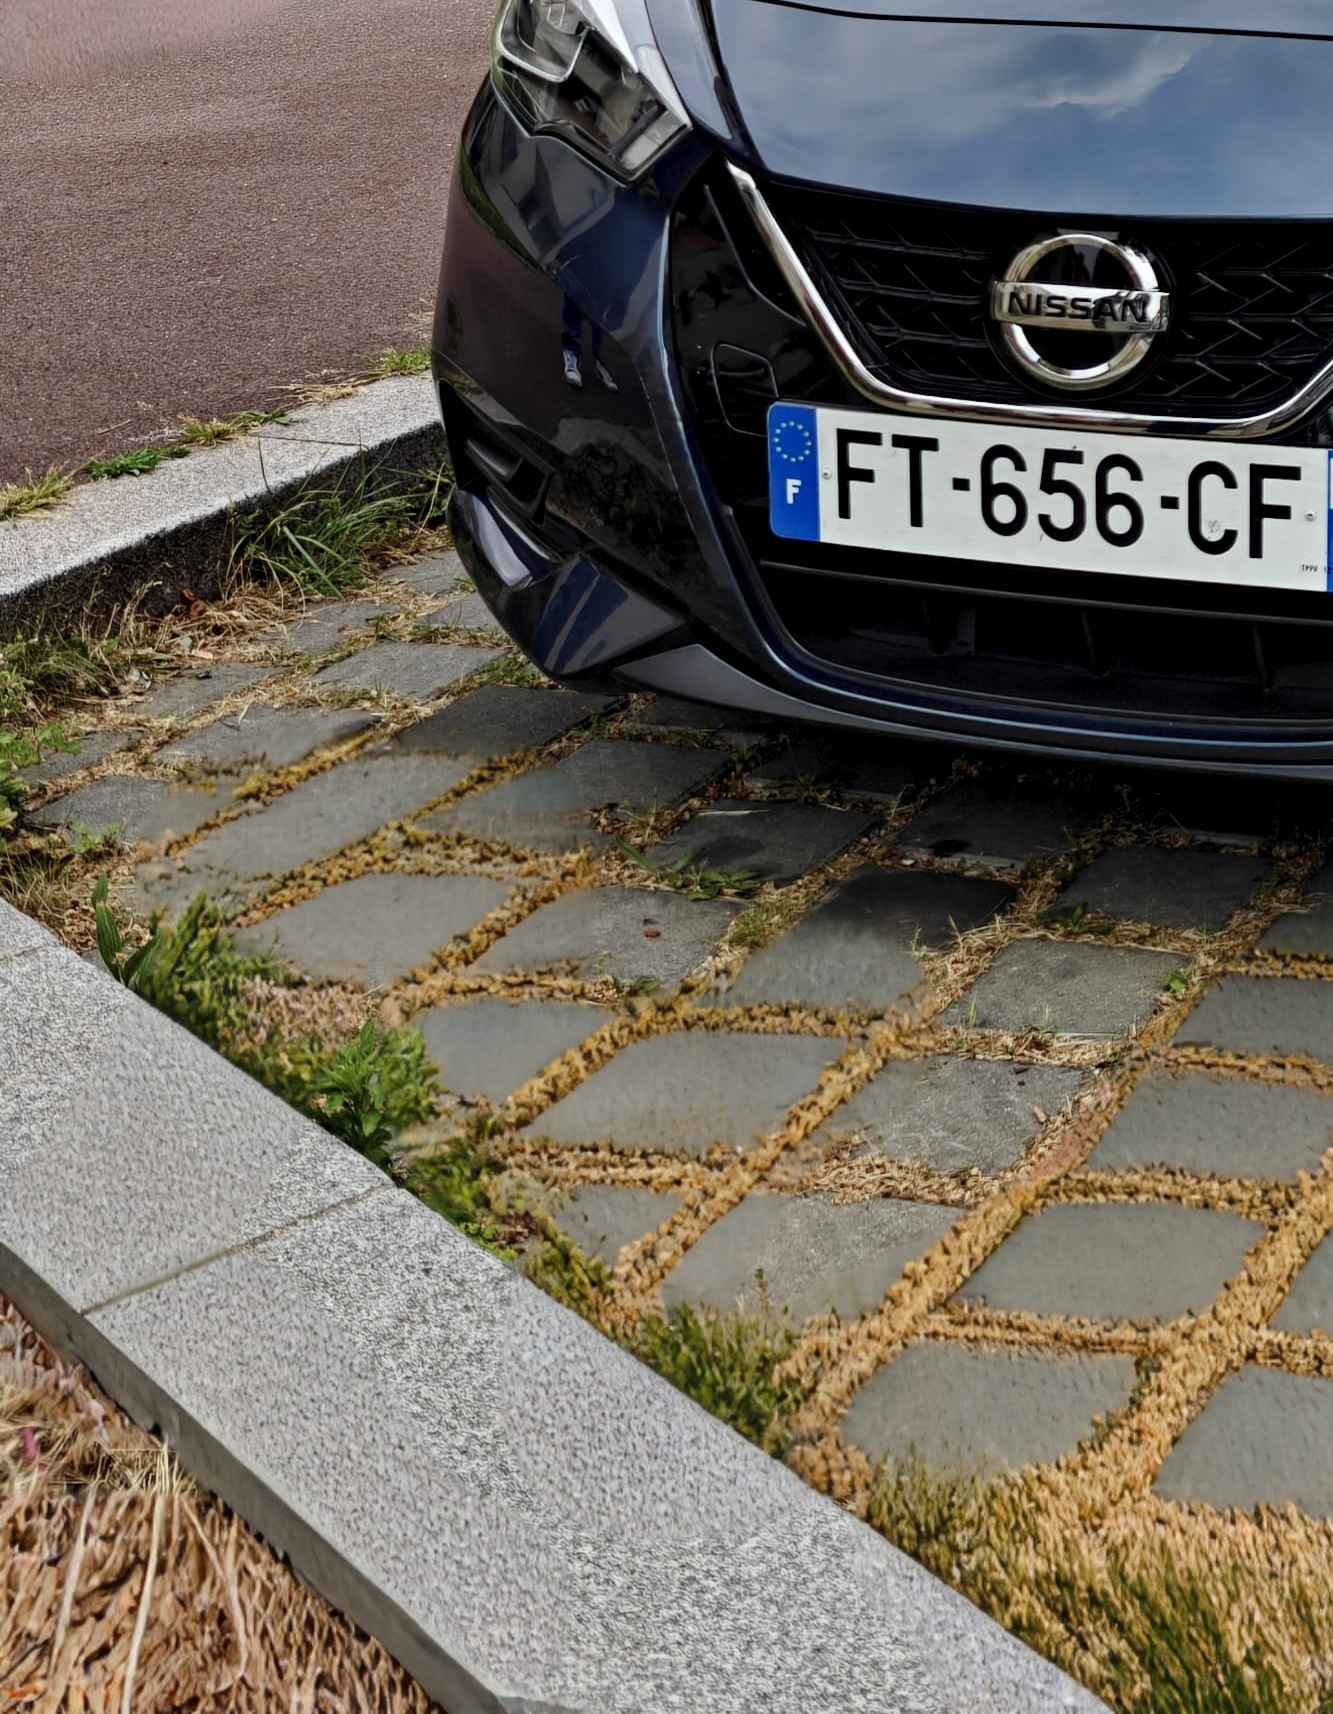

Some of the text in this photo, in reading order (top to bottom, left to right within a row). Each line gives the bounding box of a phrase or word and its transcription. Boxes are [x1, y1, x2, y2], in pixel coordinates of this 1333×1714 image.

[1008, 291, 1149, 323] NISSAN
[787, 478, 802, 505] F
[836, 428, 1302, 559] FT-656-CF
